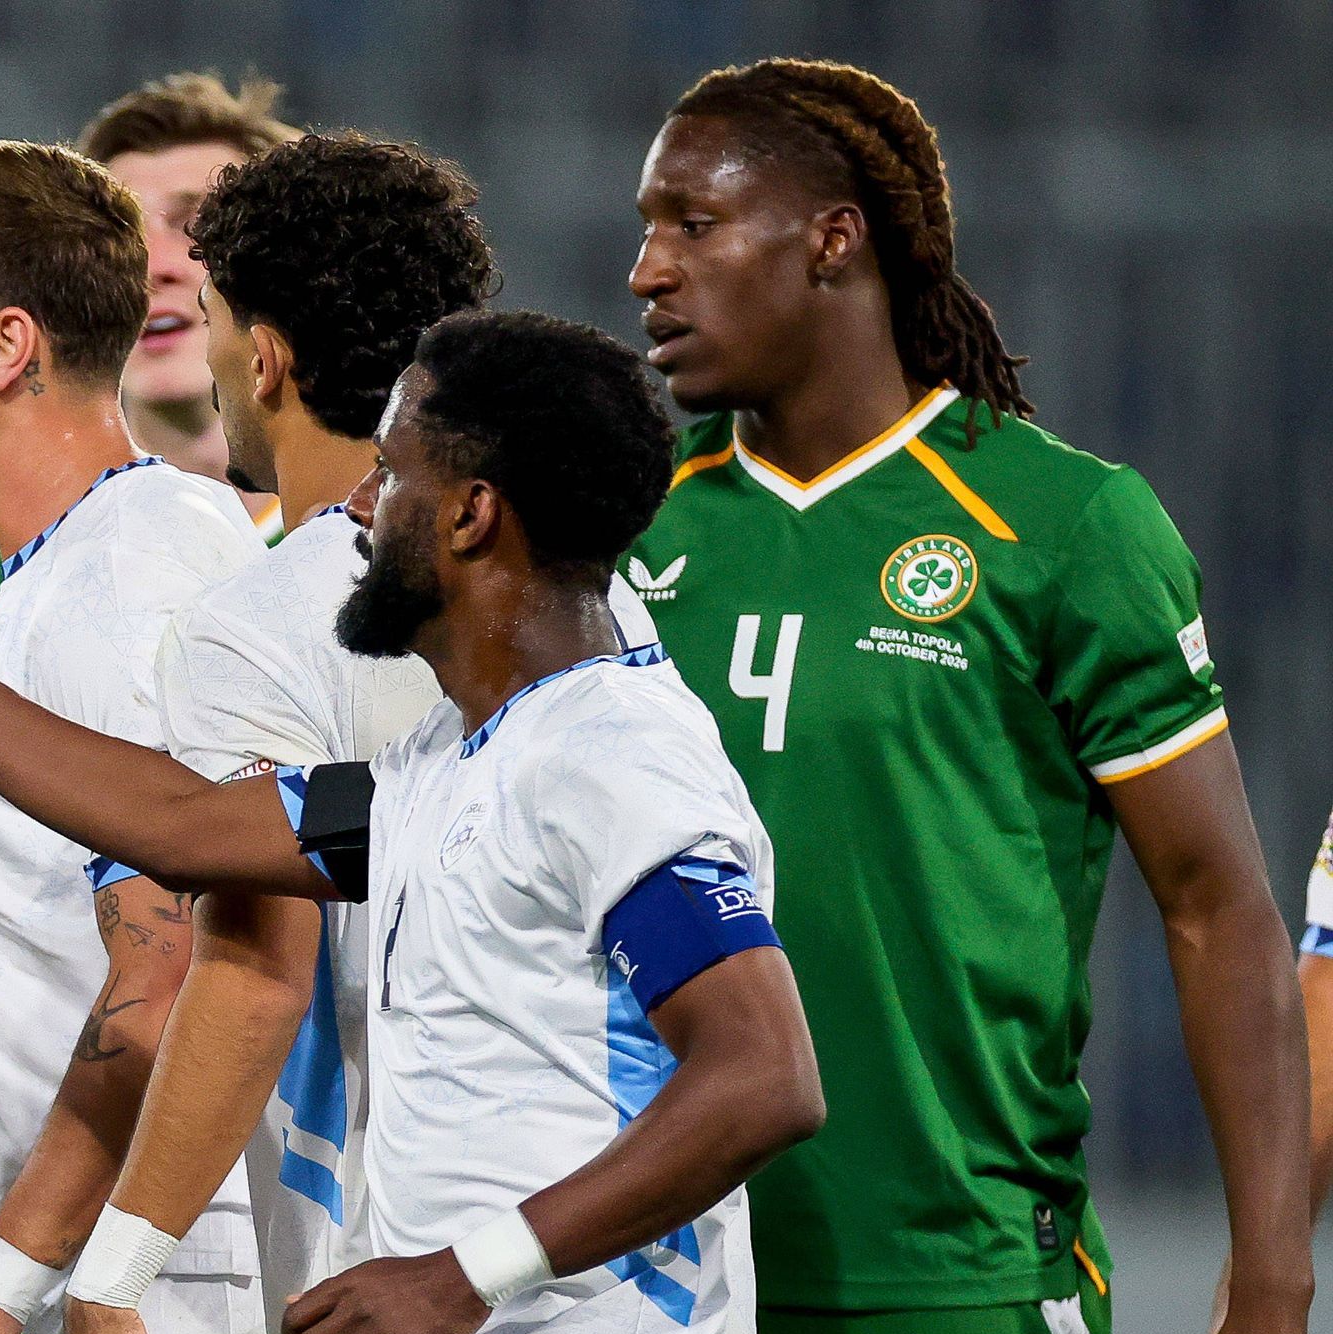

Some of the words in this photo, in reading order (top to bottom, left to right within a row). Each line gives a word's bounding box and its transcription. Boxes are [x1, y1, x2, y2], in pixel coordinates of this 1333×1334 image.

[895, 540, 971, 568] IRELAND
[855, 638, 874, 651] 4th
[876, 641, 938, 663] OCTOBER
[940, 653, 969, 671] 2026
[912, 632, 963, 655] TOPOLA
[729, 614, 803, 752] 4
